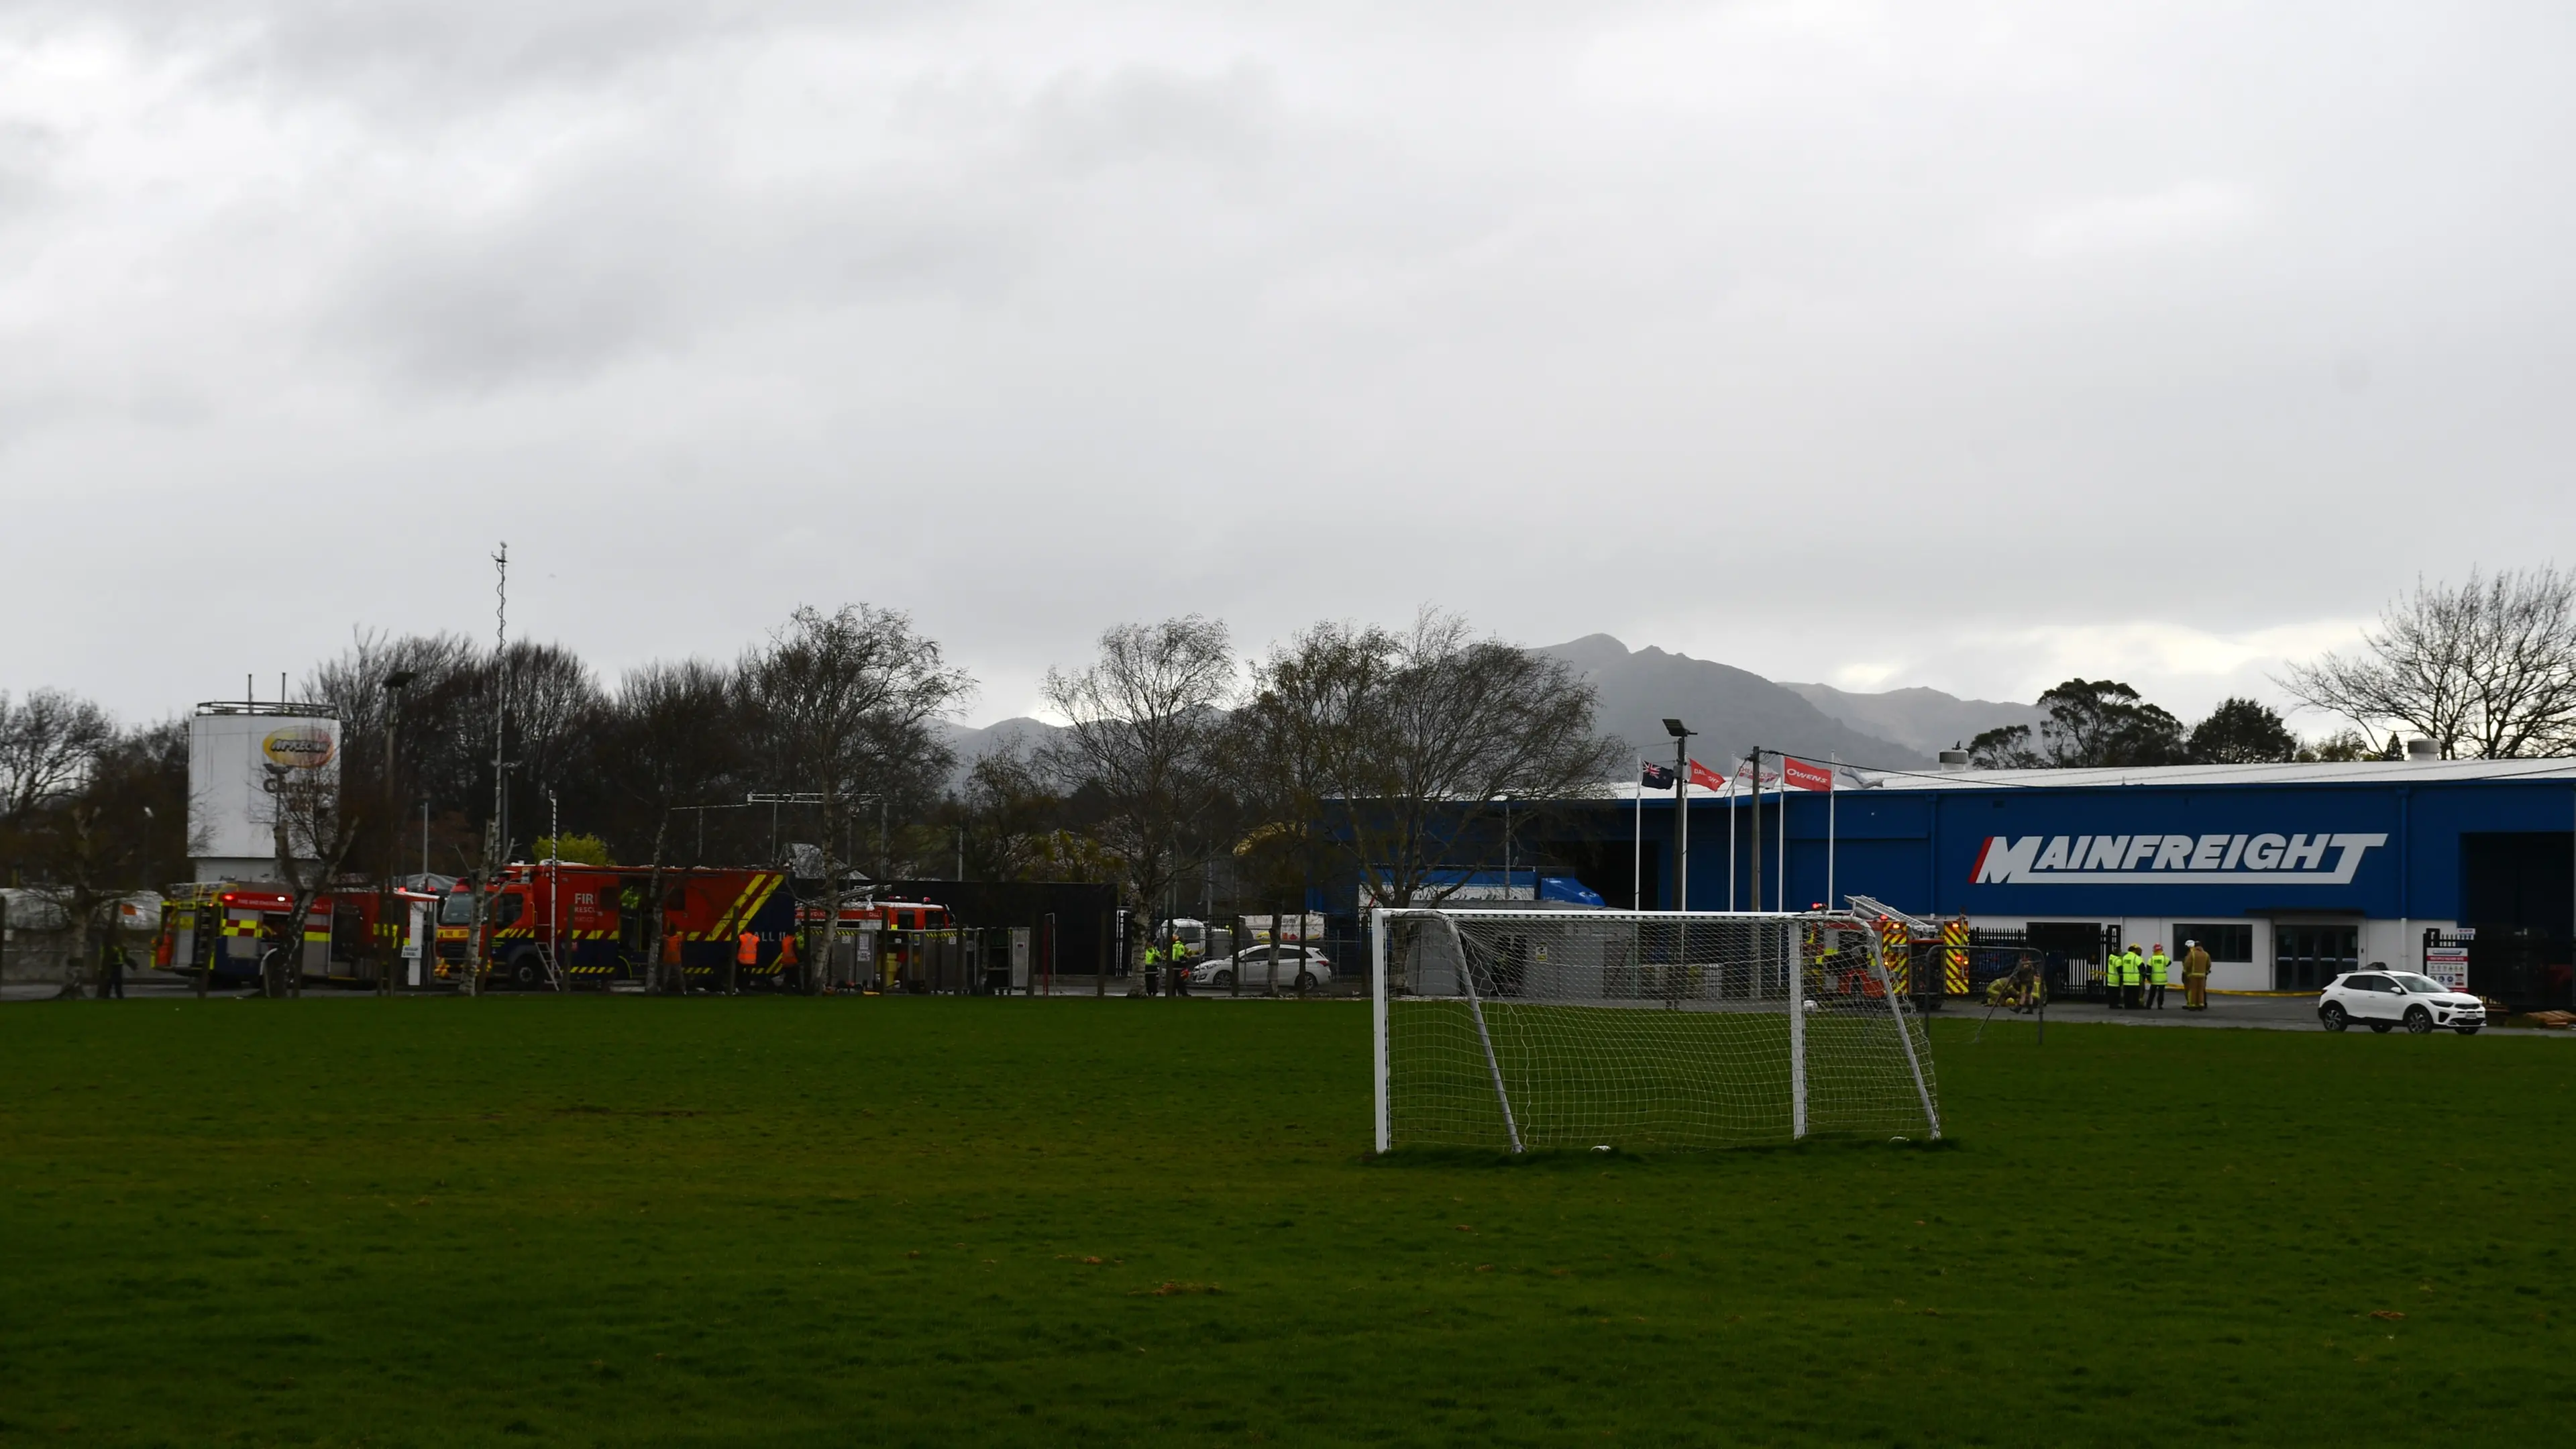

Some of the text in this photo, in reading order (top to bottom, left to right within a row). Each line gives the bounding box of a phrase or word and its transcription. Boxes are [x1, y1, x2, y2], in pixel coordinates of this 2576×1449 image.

[1786, 768, 1828, 784] OWENS
[1969, 833, 2389, 884] MAINFREIGHT
[575, 893, 598, 904] FIR
